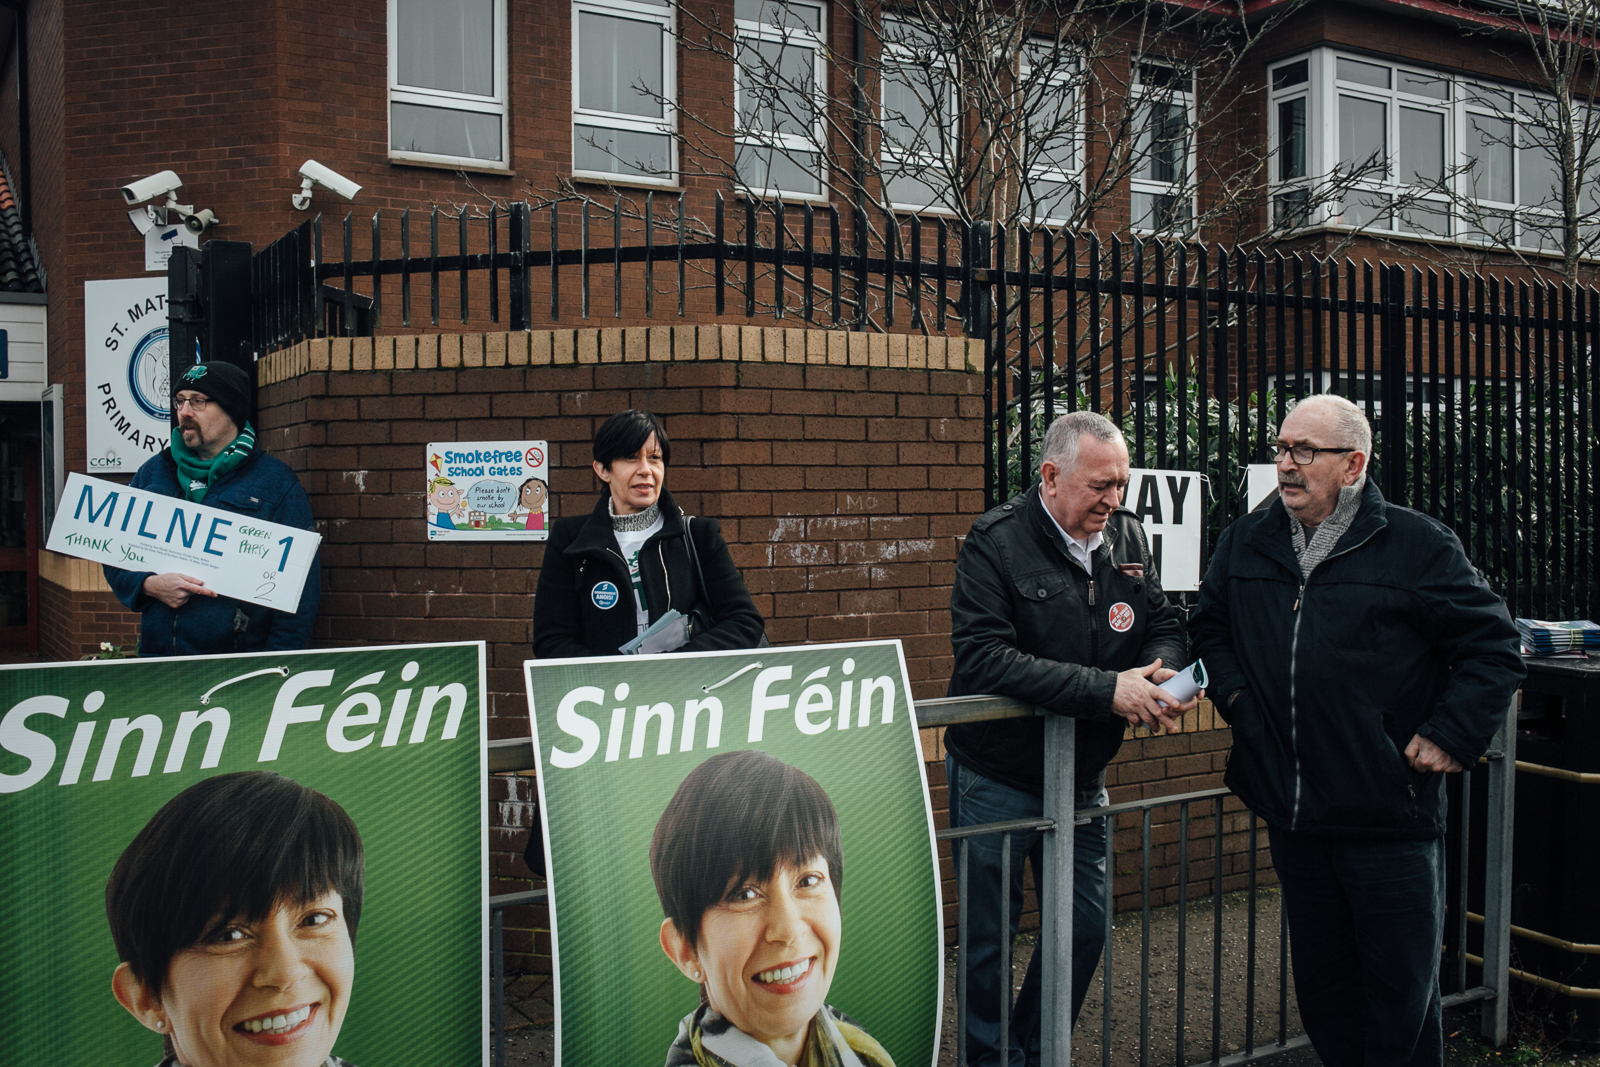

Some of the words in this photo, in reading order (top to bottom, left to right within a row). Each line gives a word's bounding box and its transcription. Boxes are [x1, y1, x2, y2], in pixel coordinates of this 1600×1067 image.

[105, 322, 129, 352] ST.
[97, 382, 169, 453] PRIMARY
[89, 457, 122, 467] CCMS
[444, 449, 523, 465] Smokefree
[497, 494, 504, 502] by
[1123, 474, 1191, 525] AY
[73, 484, 233, 557] MILNE
[278, 535, 294, 573] 1
[238, 525, 273, 540] GREEN
[65, 532, 114, 554] THANK
[238, 539, 270, 559] PARTY
[262, 571, 277, 580] OR
[253, 581, 277, 602] 2
[549, 682, 724, 769] Sinn
[747, 657, 896, 743] Féin
[0, 690, 232, 794] Sinn
[257, 660, 468, 763] Féin
